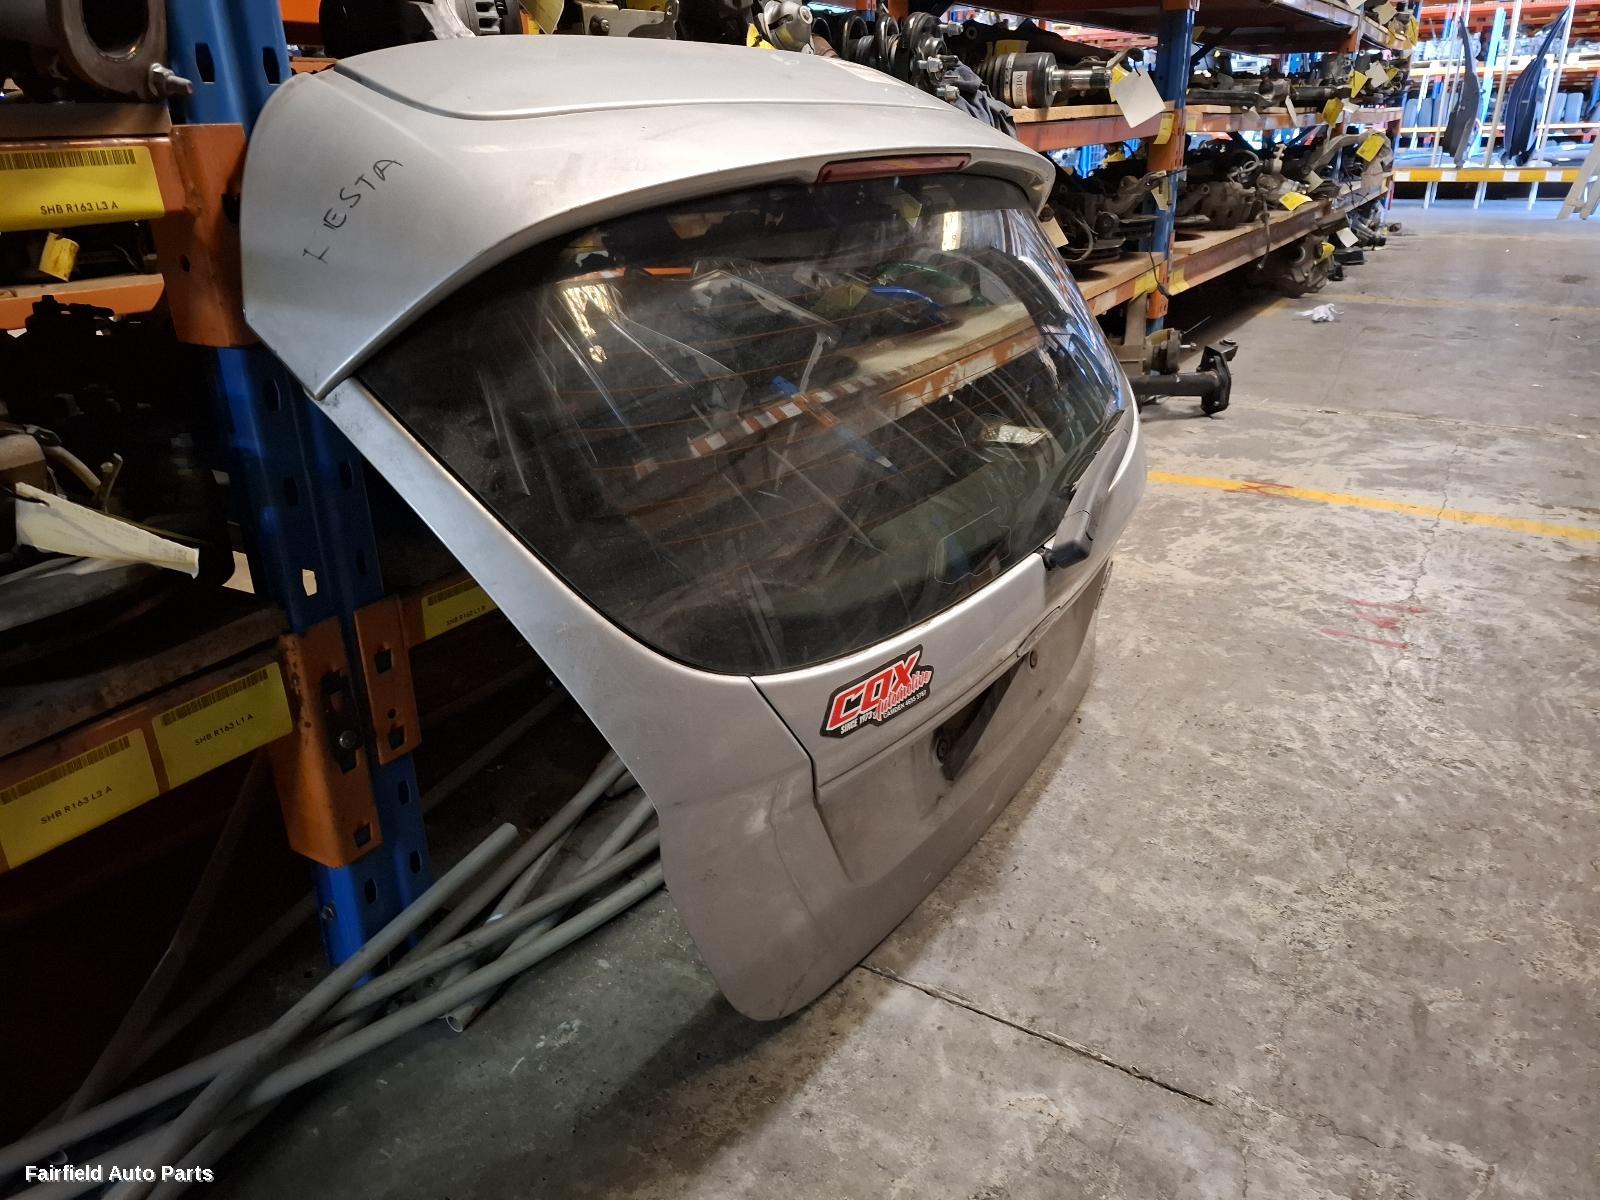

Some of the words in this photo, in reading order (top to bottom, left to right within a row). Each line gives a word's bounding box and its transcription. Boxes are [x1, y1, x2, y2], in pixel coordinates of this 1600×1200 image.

[40, 204, 64, 216] SHB
[66, 202, 94, 213] R163
[95, 200, 109, 211] L3
[111, 200, 119, 210] A
[825, 650, 921, 731] COX
[873, 670, 932, 722] Automotive
[840, 718, 858, 735] SINCE
[859, 711, 873, 724] 1973
[883, 703, 905, 720] CAMDEN
[194, 733, 212, 746] SHB
[213, 722, 234, 737] R163
[246, 713, 254, 721] A
[40, 809, 62, 825] SHB
[64, 796, 89, 813] R163
[105, 785, 112, 794] A
